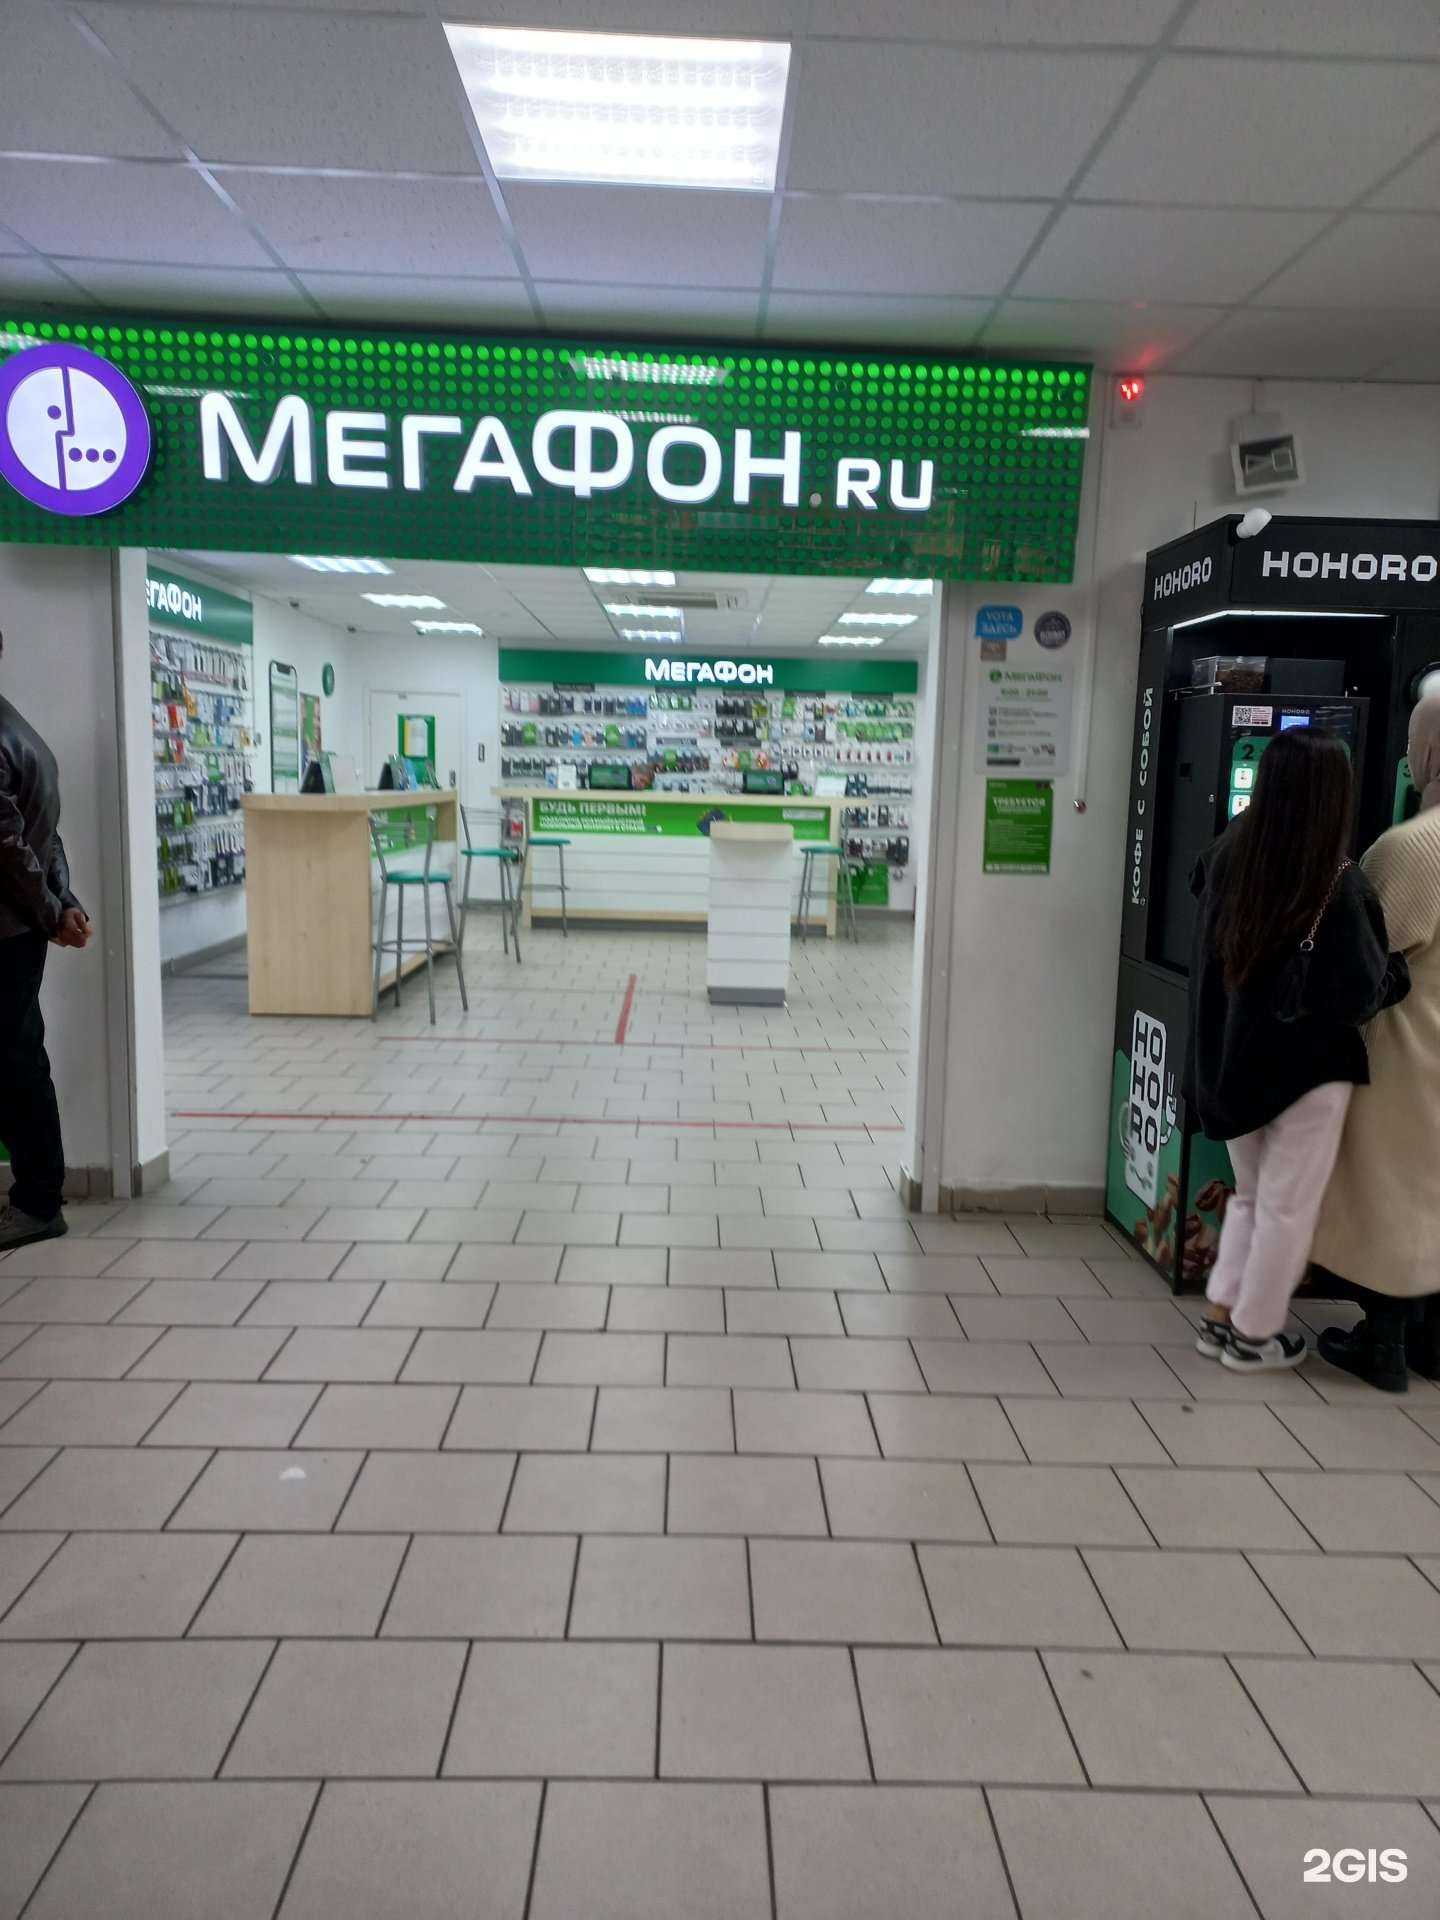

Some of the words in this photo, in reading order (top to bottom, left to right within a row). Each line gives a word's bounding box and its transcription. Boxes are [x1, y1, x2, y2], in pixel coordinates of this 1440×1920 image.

[1153, 556, 1213, 600] HOHORO
[1261, 550, 1438, 582] HOHORO
[1139, 687, 1154, 787] СОБОЙ
[1241, 744, 1255, 760] 2
[539, 801, 577, 815] БУДЬ
[1137, 799, 1146, 816] С
[1131, 828, 1144, 905] КОФЕ
